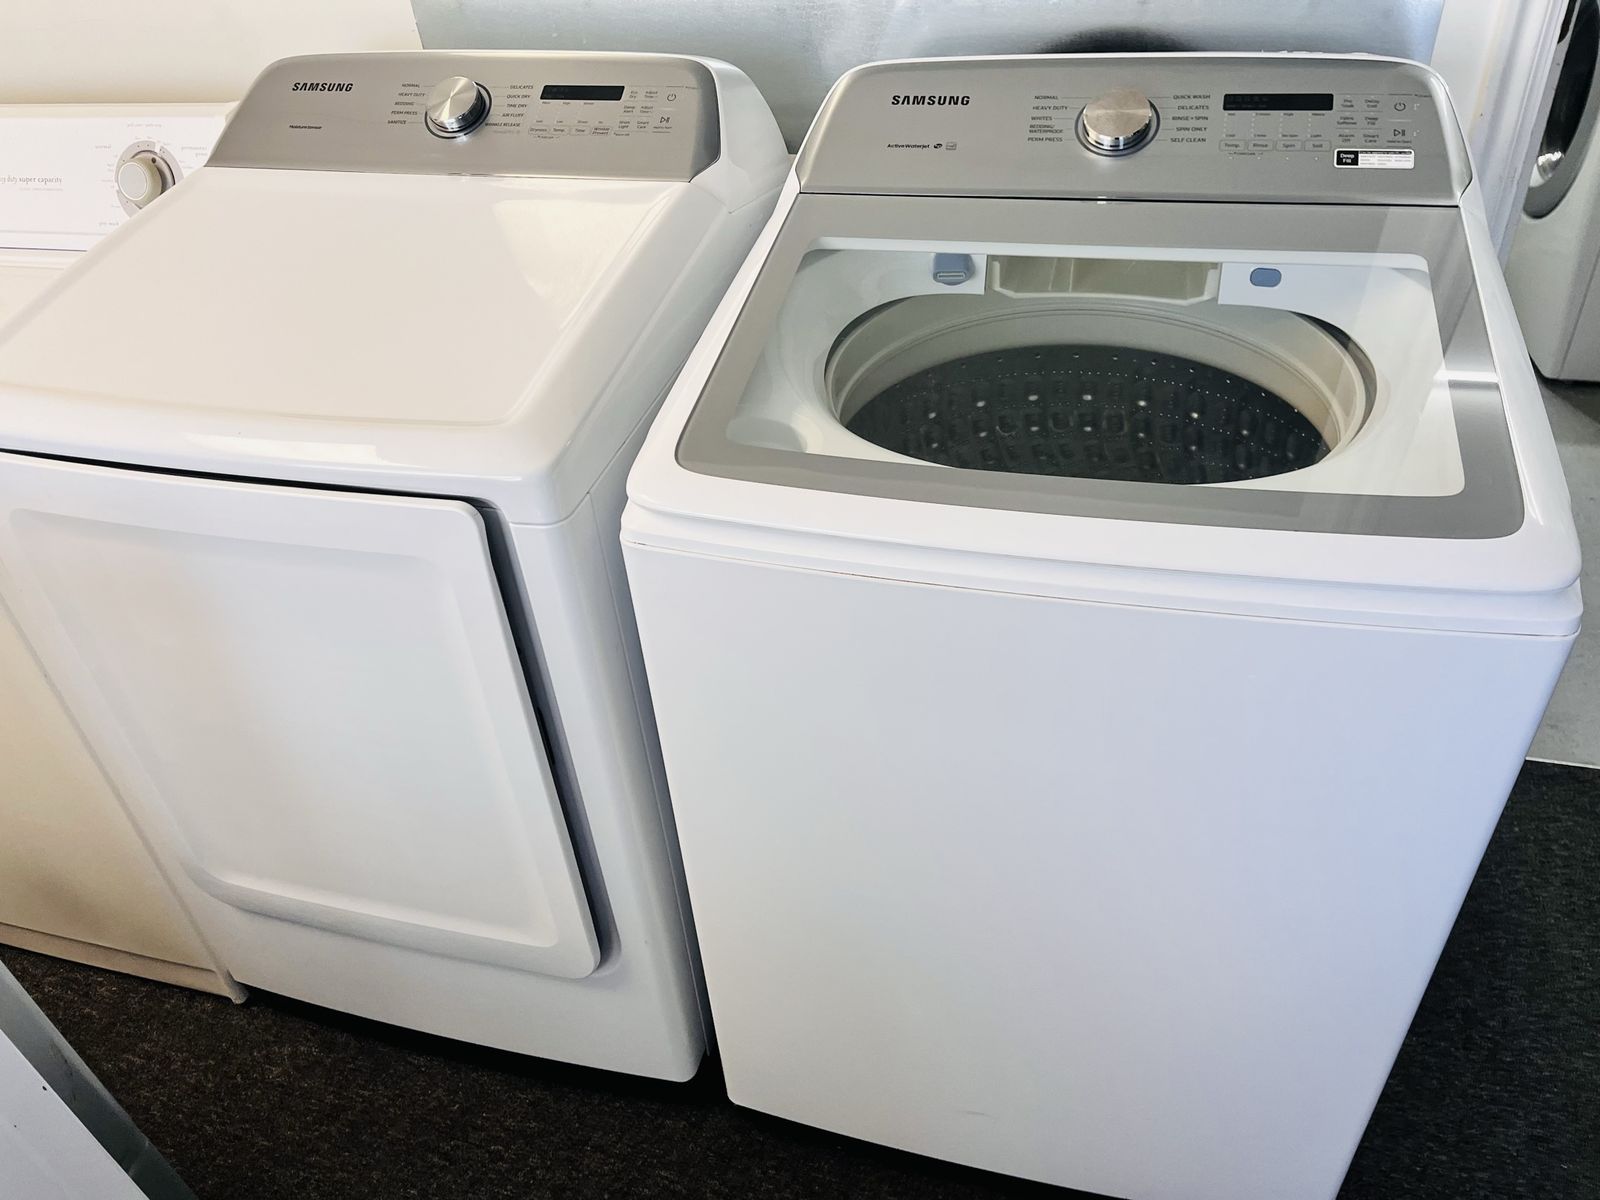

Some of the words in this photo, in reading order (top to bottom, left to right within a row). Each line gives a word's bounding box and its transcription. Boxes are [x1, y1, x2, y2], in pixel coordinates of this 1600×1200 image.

[291, 82, 354, 92] SAMSUNG
[891, 95, 971, 106] SAMSUNG
[18, 177, 36, 185] super
[38, 177, 63, 185] capacity
